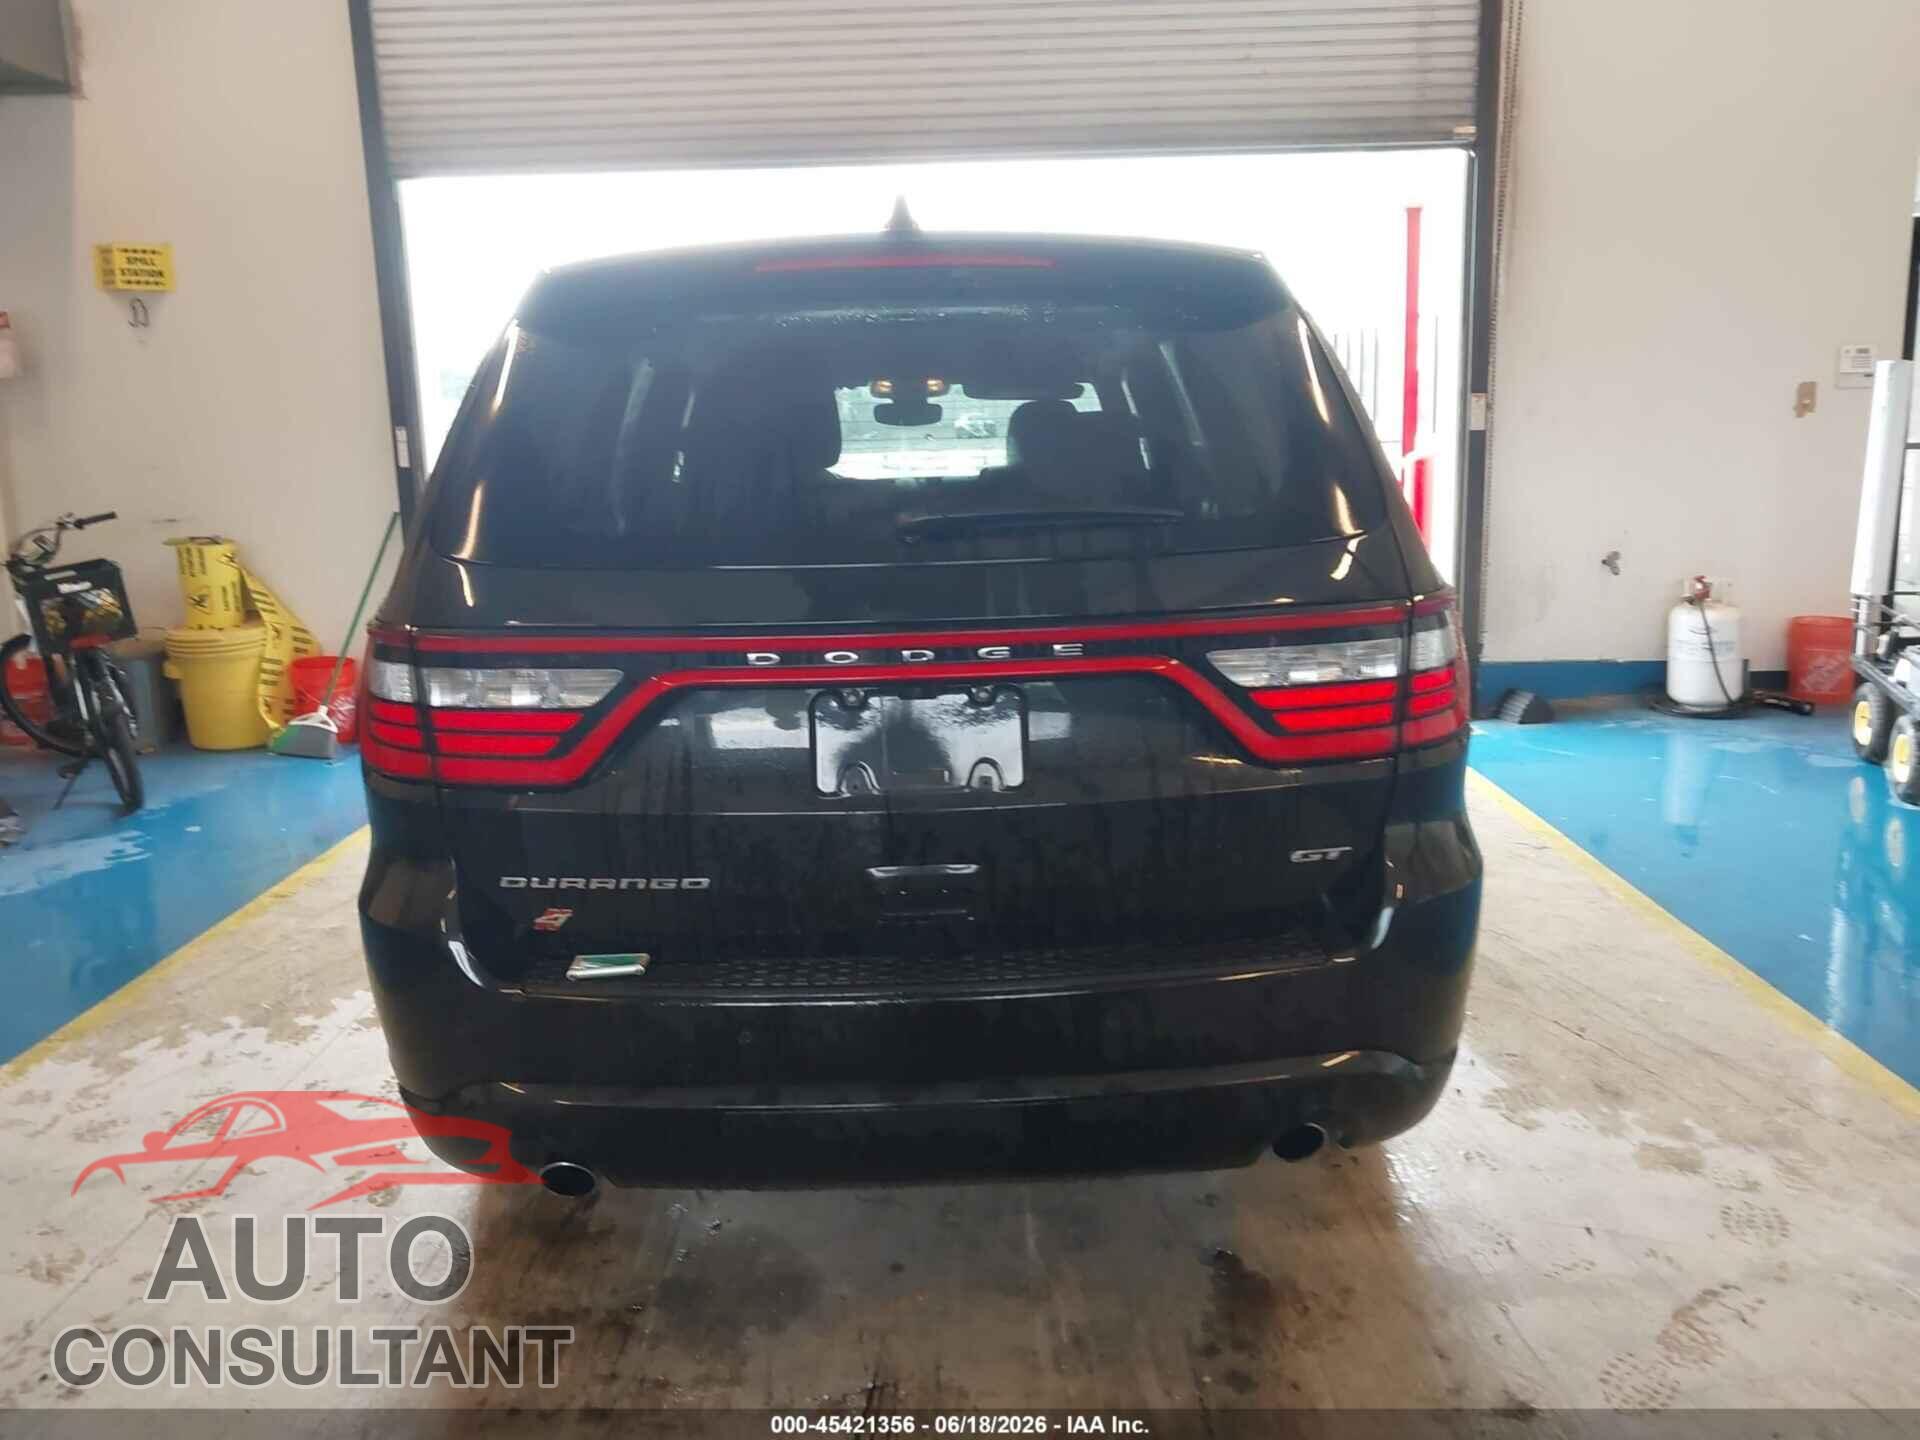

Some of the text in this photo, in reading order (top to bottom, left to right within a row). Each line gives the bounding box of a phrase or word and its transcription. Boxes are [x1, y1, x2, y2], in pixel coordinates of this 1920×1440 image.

[746, 643, 1084, 665] DODGE
[1290, 845, 1353, 864] GT
[499, 876, 711, 890] DURANGO
